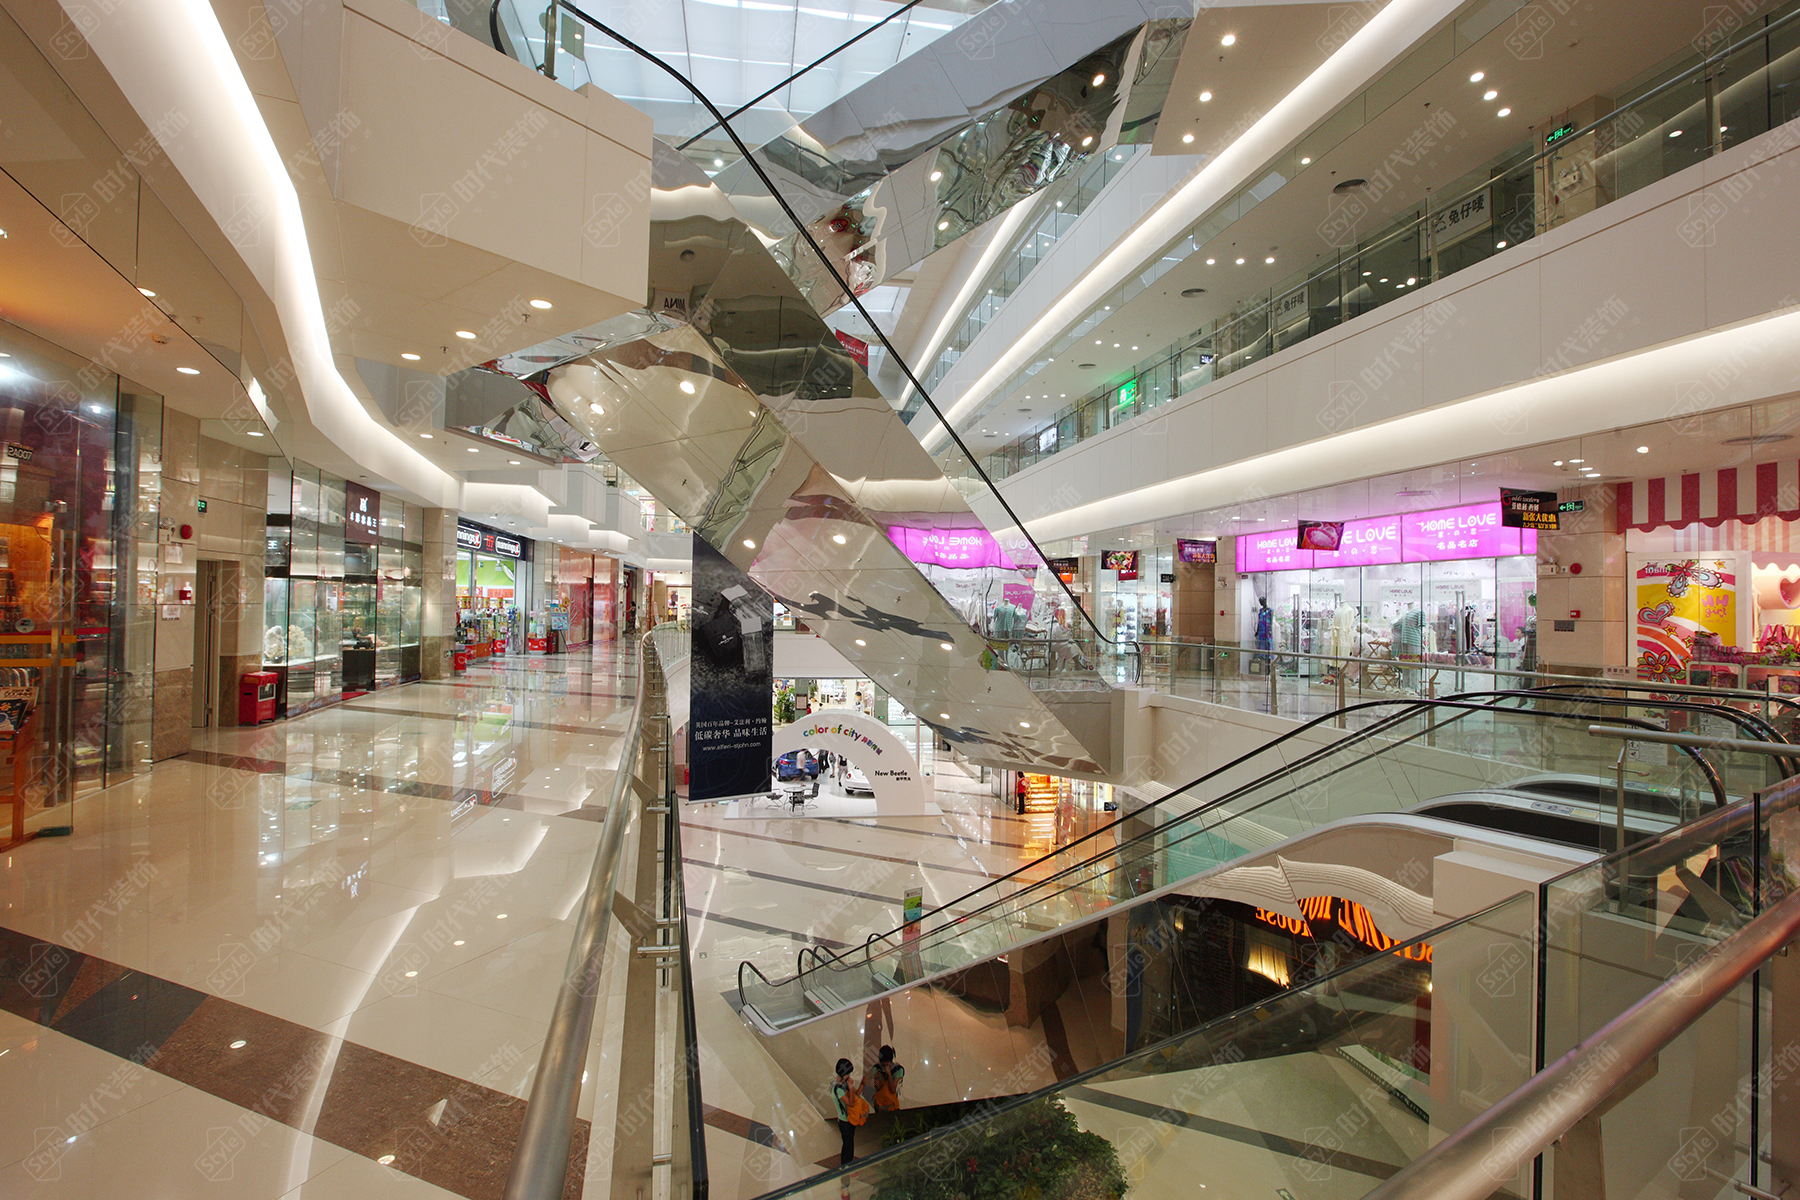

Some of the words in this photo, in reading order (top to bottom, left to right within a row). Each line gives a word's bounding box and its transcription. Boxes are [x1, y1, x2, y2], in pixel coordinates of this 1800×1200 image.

[1417, 518, 1455, 532] HOME
[1458, 513, 1496, 528] LOVE
[1356, 526, 1396, 543] LOVE
[1257, 539, 1277, 549] HOME
[1437, 539, 1479, 550] 名品名店
[695, 729, 731, 741] 低碳奢华
[733, 727, 768, 738] 品味生活
[803, 724, 829, 737] color
[831, 724, 843, 734] of
[843, 728, 862, 741] city
